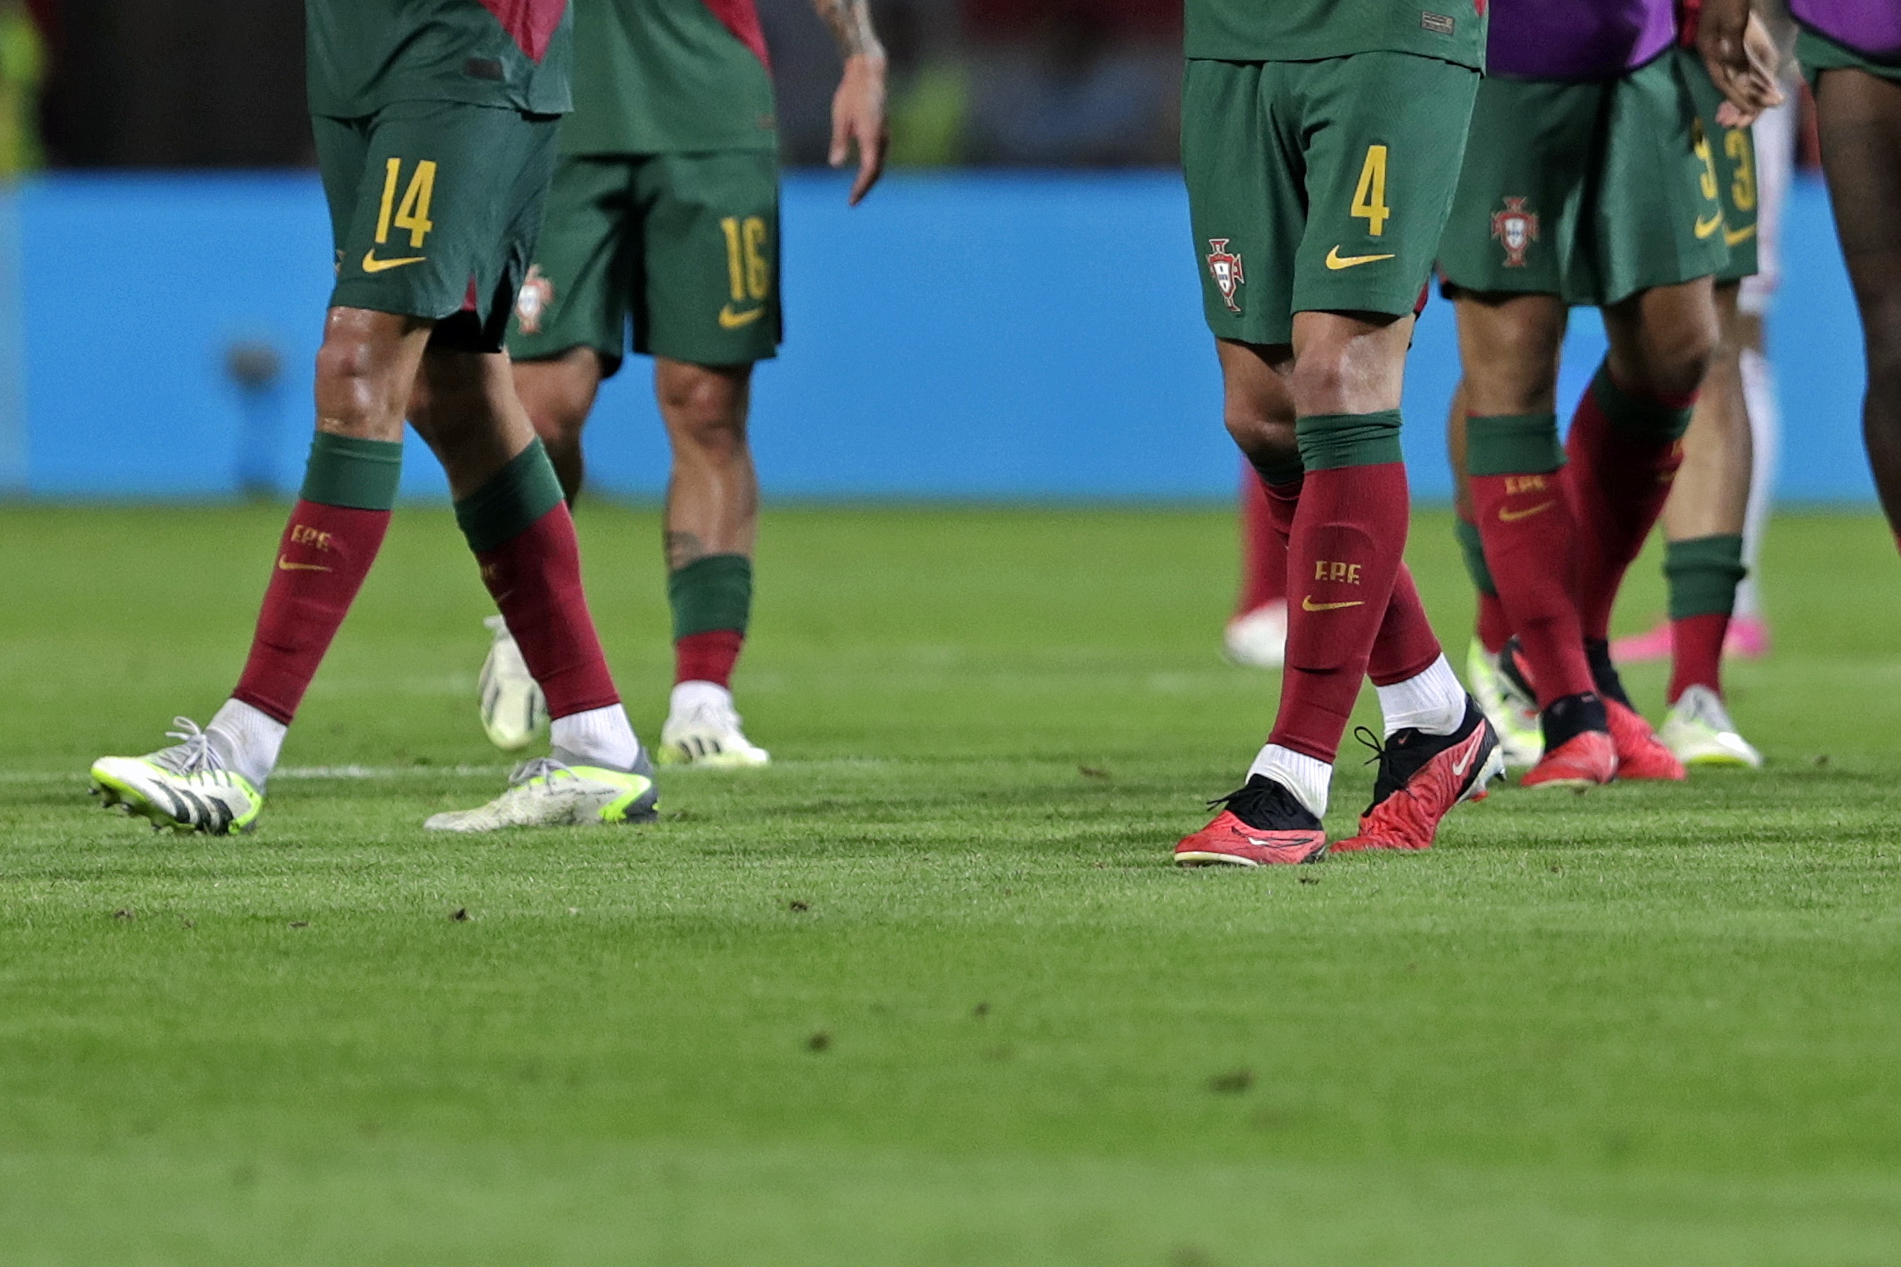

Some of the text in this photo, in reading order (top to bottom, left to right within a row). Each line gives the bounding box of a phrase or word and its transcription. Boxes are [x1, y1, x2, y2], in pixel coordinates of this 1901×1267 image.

[374, 157, 437, 248] 14
[1351, 145, 1390, 236] 4
[720, 216, 768, 302] 16
